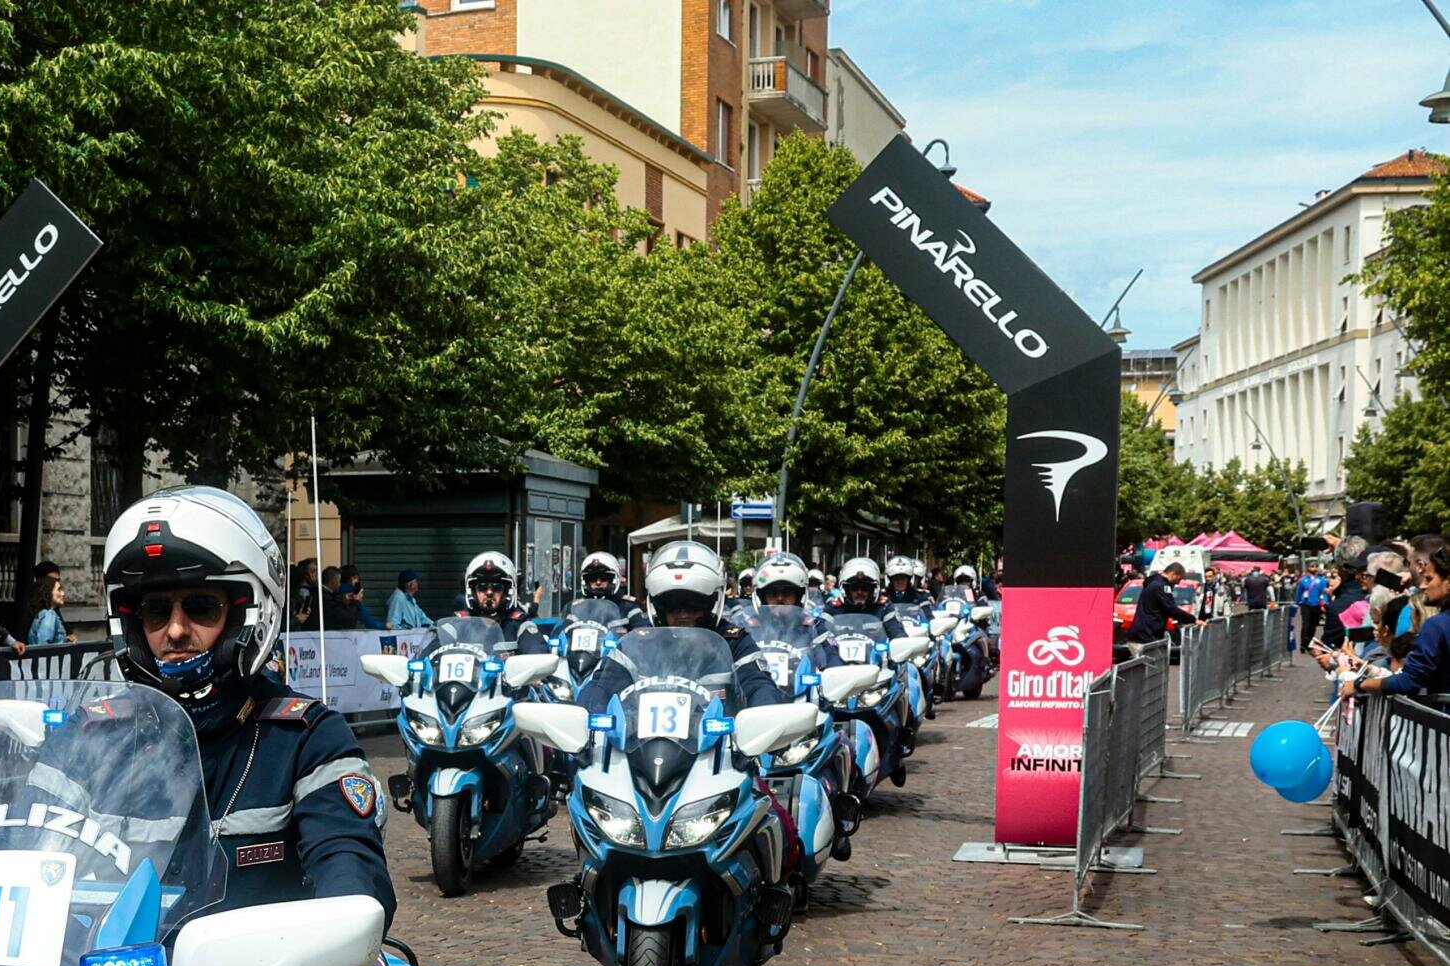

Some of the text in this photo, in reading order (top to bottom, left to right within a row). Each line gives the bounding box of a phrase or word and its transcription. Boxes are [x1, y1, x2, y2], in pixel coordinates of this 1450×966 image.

[869, 186, 1048, 359] PINARELLO
[577, 635, 592, 649] 18
[845, 646, 860, 659] 17
[446, 661, 465, 678] 16
[619, 675, 711, 702] POLIZIA
[1007, 669, 1102, 698] Giro d'Itali
[1007, 700, 1040, 709] AMORE
[1041, 701, 1080, 709] INFINITO
[650, 705, 677, 733] 13
[1016, 744, 1083, 758] AMOR
[1010, 757, 1082, 772] INFINIT
[239, 847, 281, 862] POLIZIA
